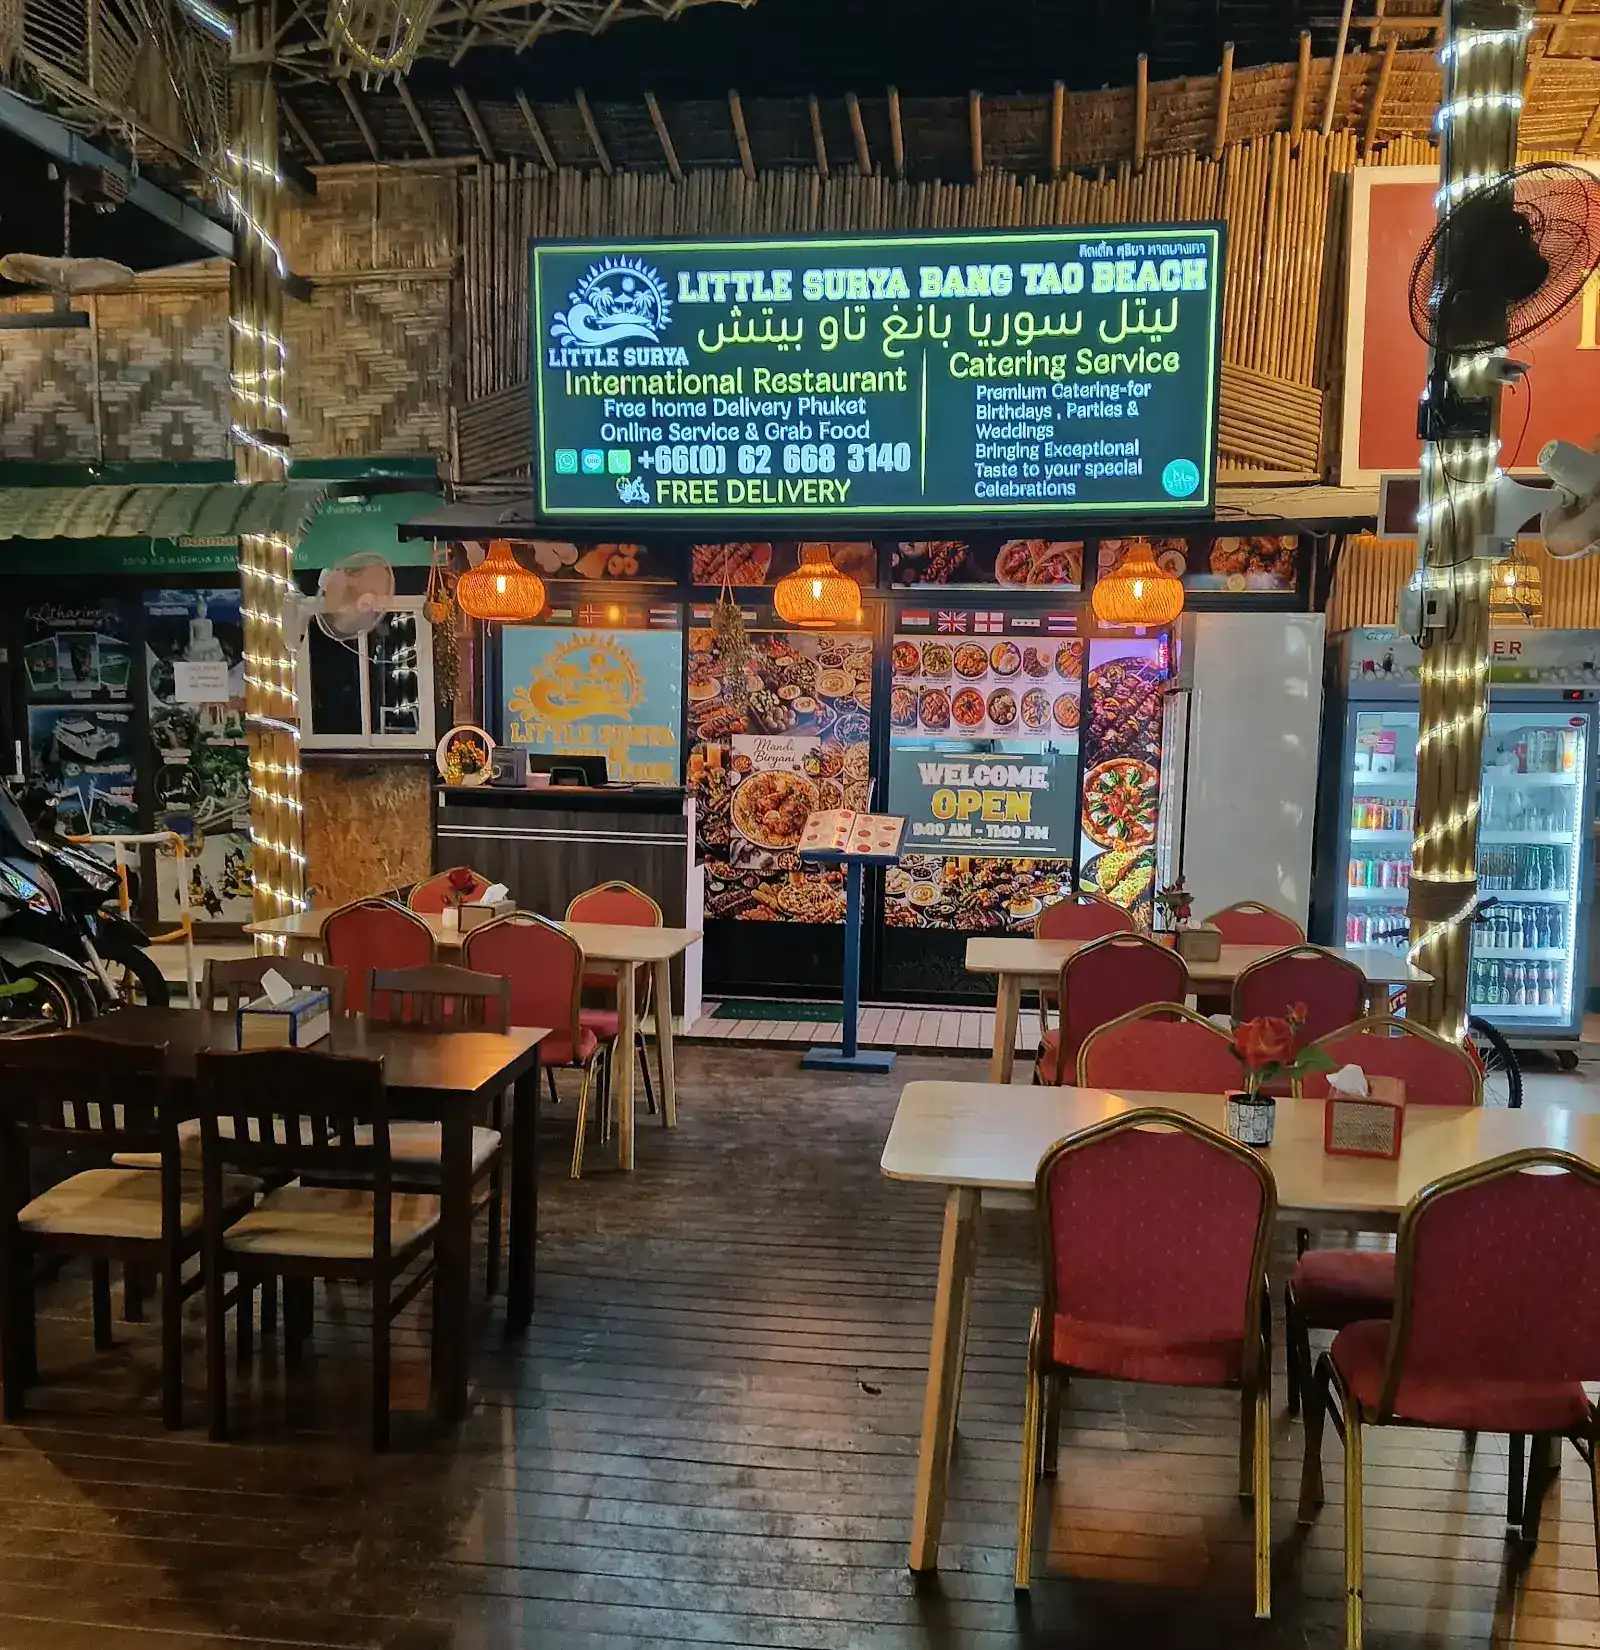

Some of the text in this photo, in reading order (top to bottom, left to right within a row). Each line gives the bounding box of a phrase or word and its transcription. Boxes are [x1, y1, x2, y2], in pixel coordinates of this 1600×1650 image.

[677, 258, 1207, 303] LITTLE SURYA BANG TAO BEACH
[697, 297, 1178, 359] ليتل سوريا بانغ تاو بيتش
[548, 346, 690, 367] LITTLE SURYA
[950, 346, 1180, 381] Catering Service
[566, 366, 907, 396] International Restaurant
[976, 383, 1047, 401] Premium
[603, 395, 867, 420] Free home Delivery Phuket
[1066, 401, 1123, 418] Parties
[1126, 400, 1139, 417] &
[601, 419, 870, 443] Online Service & Grab Food
[976, 422, 1054, 440] Weddings
[637, 442, 911, 475] +66(0) 62 668 3140
[975, 438, 1140, 461] Bringing Exceptional
[974, 458, 1143, 480] Taste to your special
[656, 478, 851, 503] FREE DELIVERY
[974, 480, 1076, 498] Celebrations
[510, 723, 596, 743] LITTLE
[753, 738, 794, 751] Mandi
[754, 750, 796, 768] Biryani
[918, 763, 1049, 789] WELCOME
[931, 789, 1033, 822] OPEN
[948, 823, 971, 837] AM
[1024, 825, 1049, 840] PM
